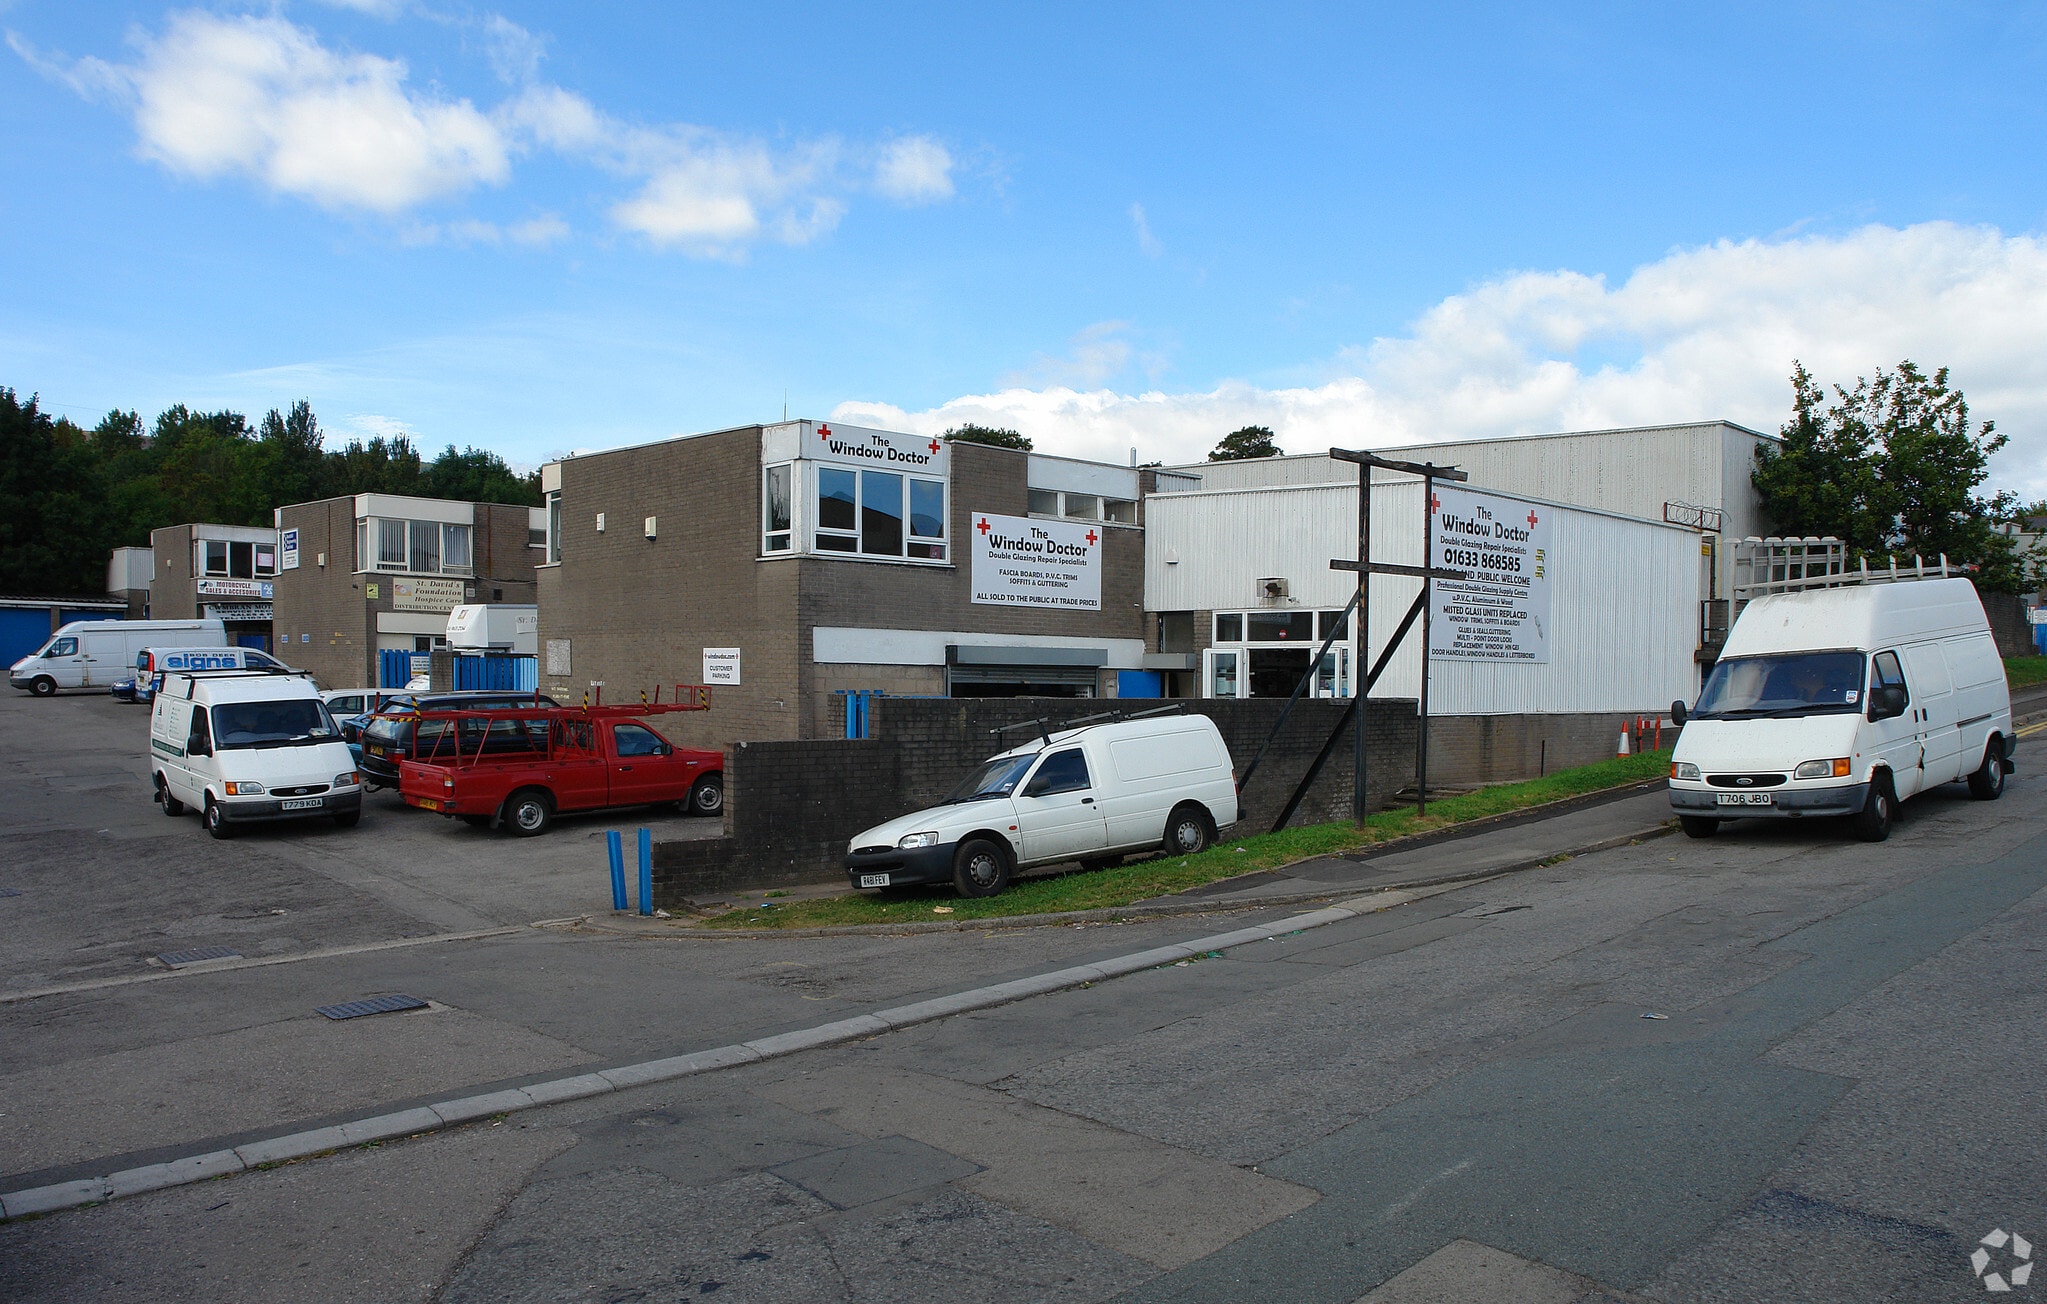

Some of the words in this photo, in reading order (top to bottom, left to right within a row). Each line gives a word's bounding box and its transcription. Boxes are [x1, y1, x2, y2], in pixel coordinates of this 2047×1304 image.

[872, 435, 890, 447] The
[829, 440, 884, 459] Window
[887, 447, 930, 465] Doctor
[1477, 506, 1492, 520] The
[1031, 527, 1049, 539] The
[1442, 513, 1491, 537] Window
[1494, 522, 1530, 543] Doctor
[989, 534, 1043, 553] Window
[1047, 540, 1088, 557] Doctor
[1440, 535, 1460, 546] Double
[1461, 538, 1482, 550] Glazing
[1483, 541, 1501, 552] Repair
[1502, 544, 1527, 555] Specialists
[988, 551, 1012, 560] Double
[1012, 553, 1036, 563] Glazing
[1037, 555, 1058, 565] Repair
[1058, 557, 1088, 566] Specialists
[1444, 548, 1479, 568] 01633
[1481, 553, 1521, 572] 868585
[999, 568, 1020, 577] FASCIA
[1020, 570, 1045, 579] BOARDS,
[1062, 573, 1078, 581] TRIMS
[1477, 572, 1500, 582] PUBLIC
[1501, 575, 1531, 586] WELCOME
[430, 580, 461, 588] David's
[1009, 578, 1031, 586] SOFFITS
[1037, 580, 1069, 588] GUTTERING
[1437, 581, 1465, 590] Professional
[1465, 584, 1481, 592] Double
[1481, 585, 1498, 595] Glazing
[1498, 587, 1513, 596] Supply
[1514, 589, 1528, 597] Centre
[414, 587, 462, 596] Foundation
[414, 596, 444, 604] Hospice
[976, 592, 988, 600] ALL
[989, 593, 1006, 601] SOLD
[1006, 594, 1015, 602] TO
[1029, 596, 1050, 604] PUBLIC
[1079, 599, 1098, 607] PRICES
[1443, 605, 1464, 615] MISTED
[1465, 607, 1482, 616] GLASS
[1482, 608, 1499, 617] UNITS
[1499, 610, 1528, 619] REPLACED
[1431, 648, 1446, 656] DOOR
[1453, 641, 1484, 649] REPLACEMENT
[167, 653, 237, 670] signs
[284, 800, 305, 809] T779
[1718, 794, 1746, 803] T706
[1748, 794, 1769, 803] JBO
